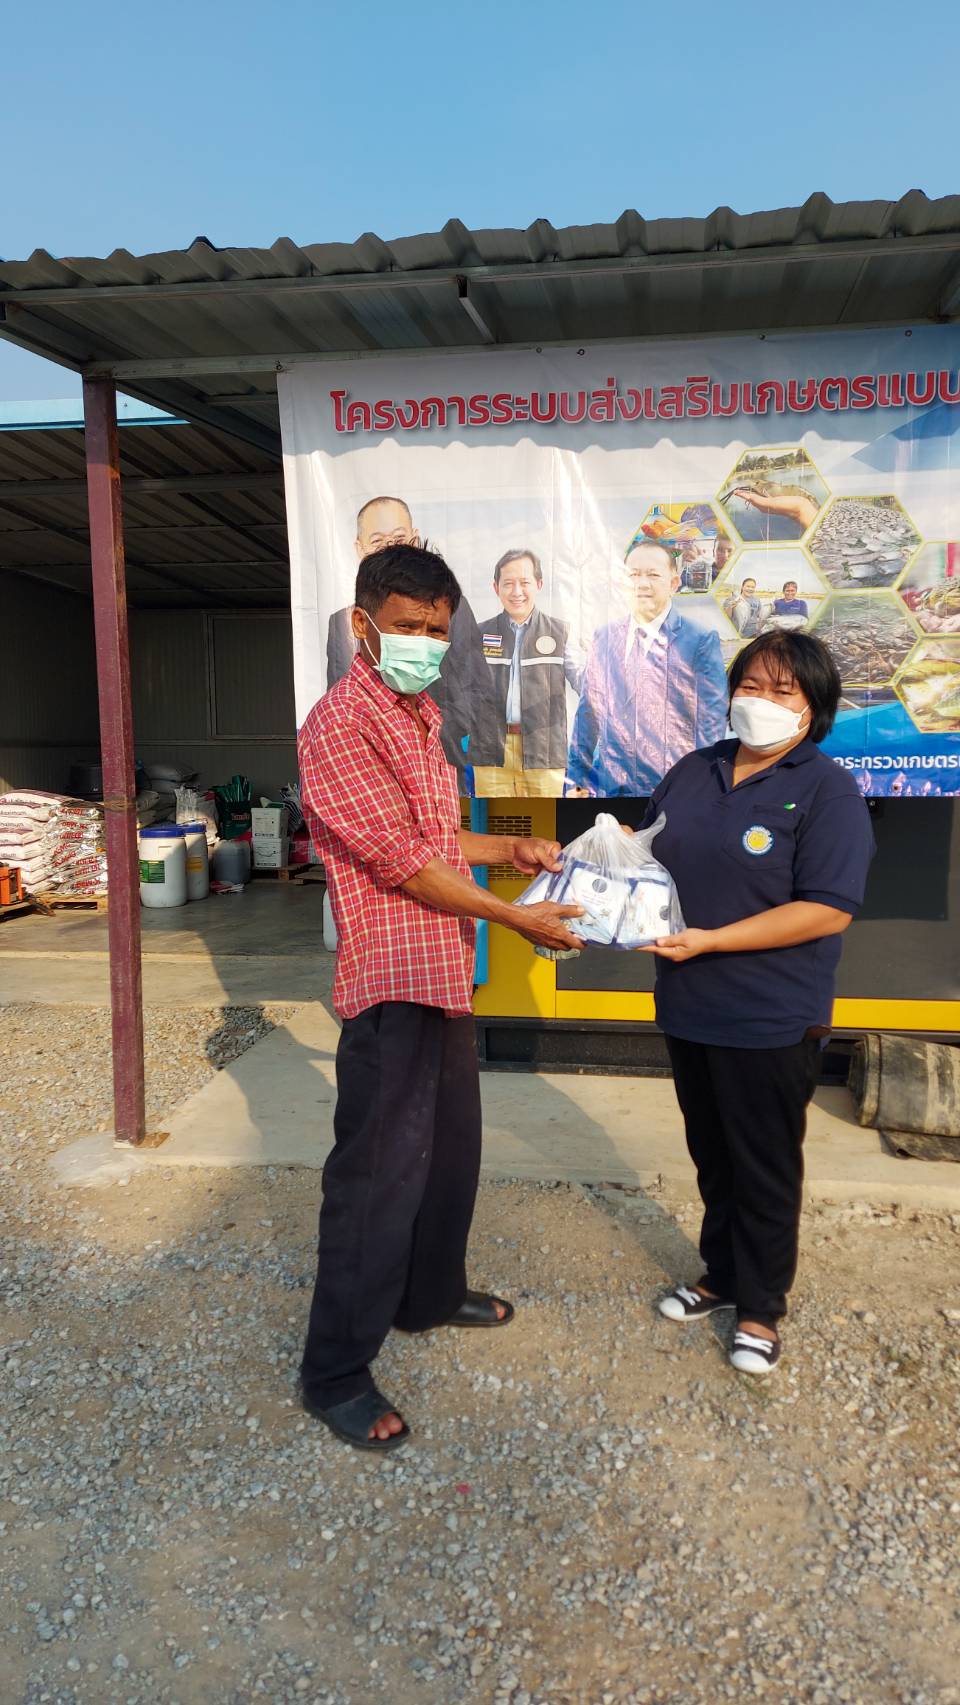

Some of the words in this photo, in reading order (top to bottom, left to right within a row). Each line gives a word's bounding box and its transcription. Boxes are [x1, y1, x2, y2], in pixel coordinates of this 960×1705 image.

[329, 367, 960, 433] โครงการระบบส่งเสริมเกษตรแบบ
[833, 755, 960, 769] กระทรวงเกษตร
